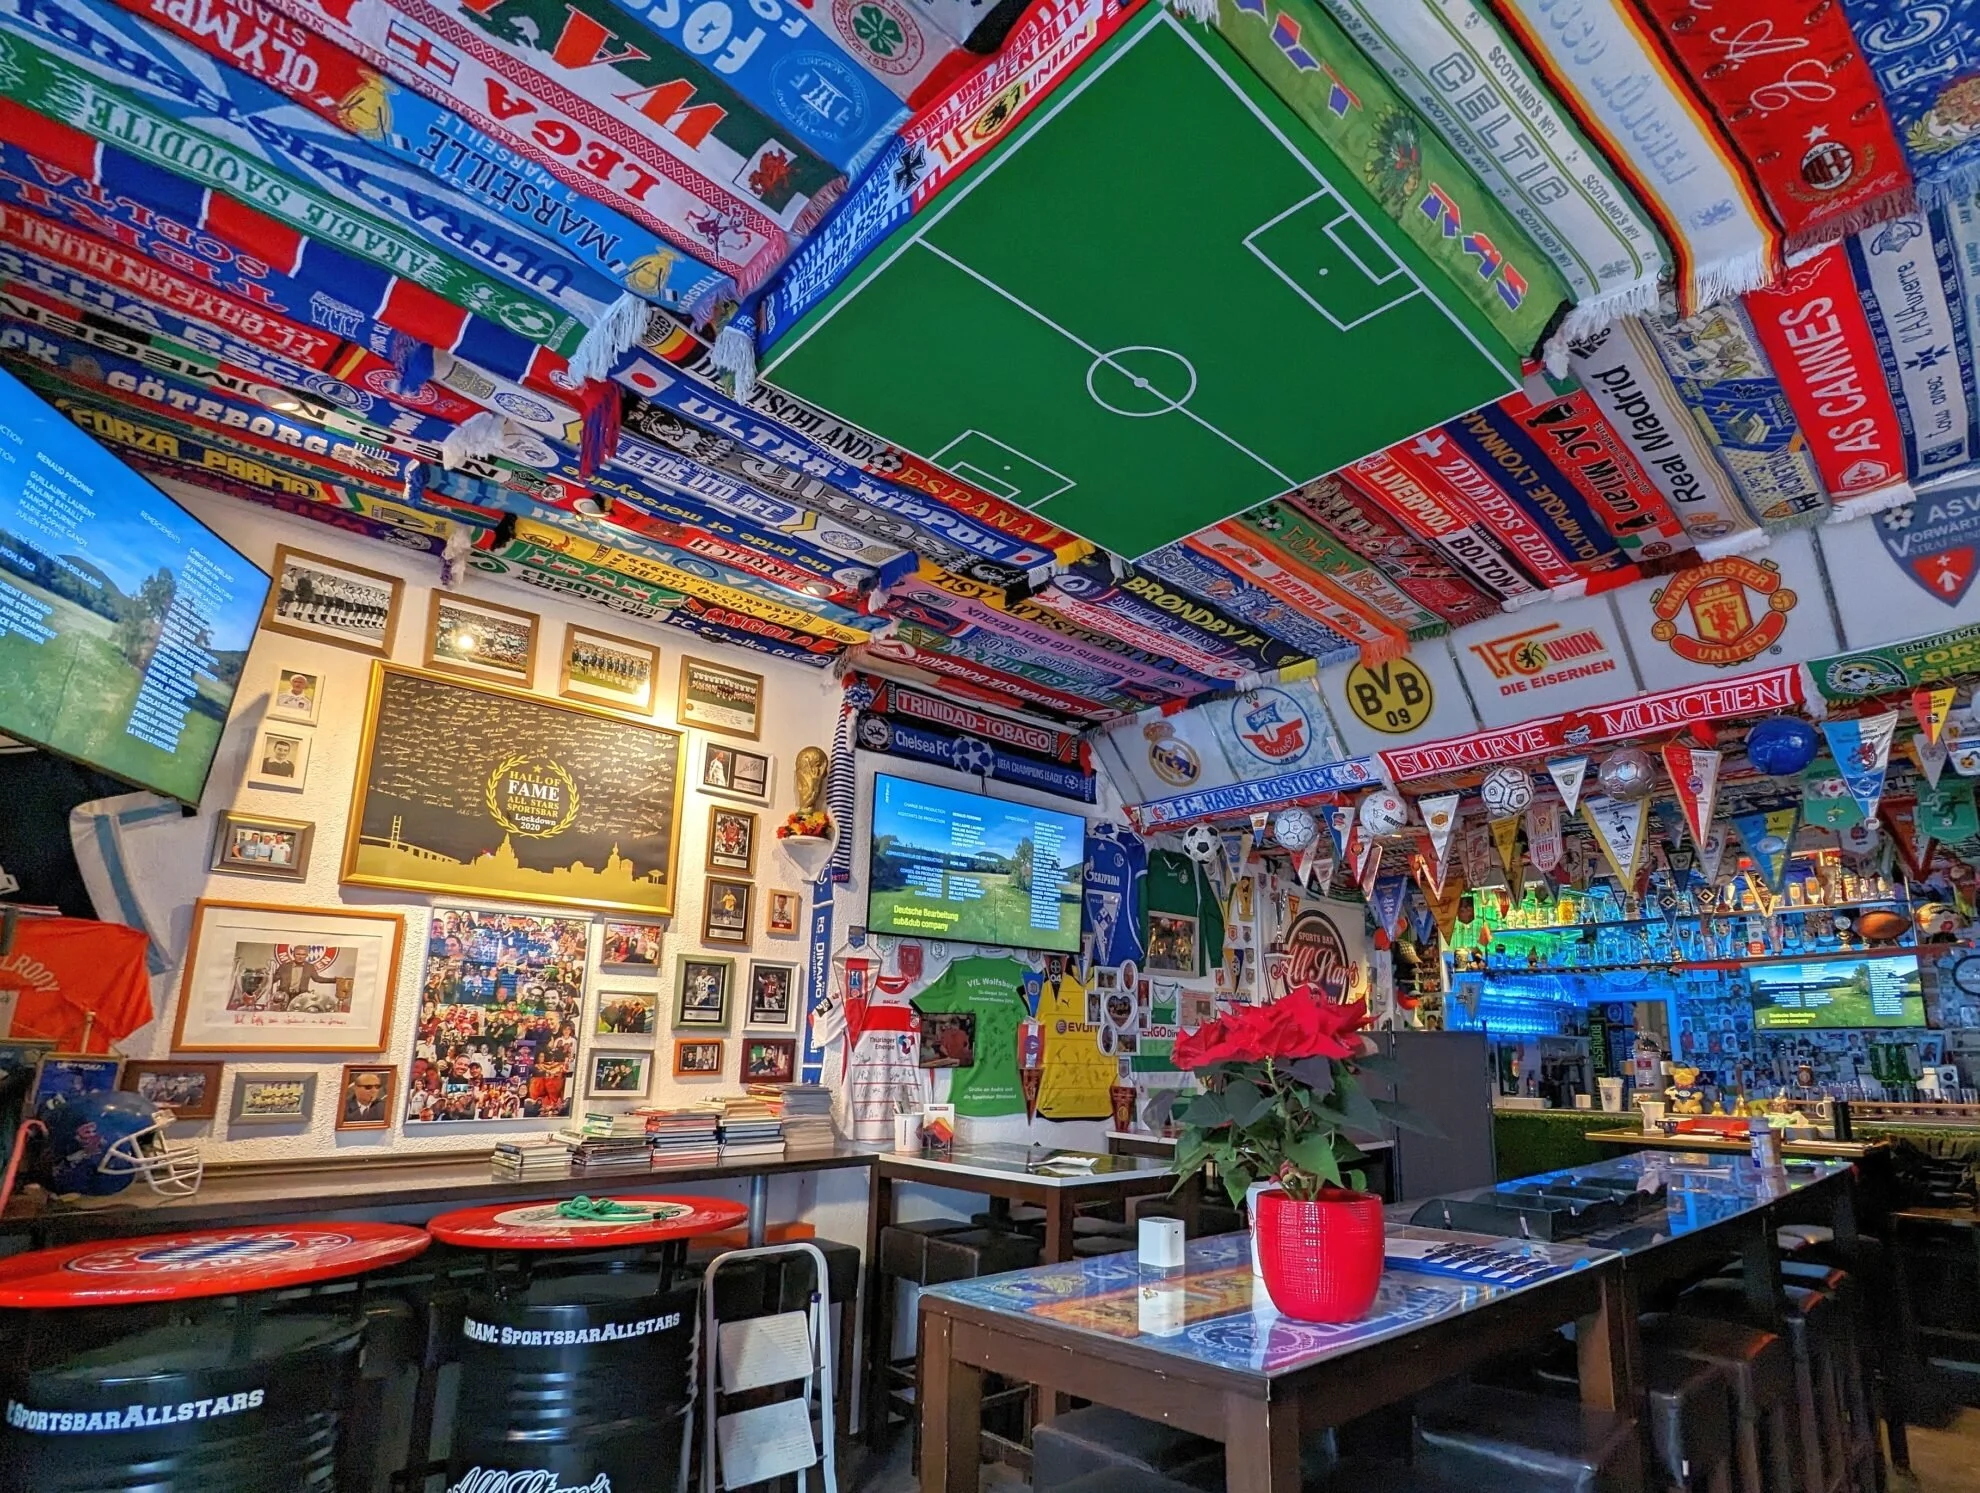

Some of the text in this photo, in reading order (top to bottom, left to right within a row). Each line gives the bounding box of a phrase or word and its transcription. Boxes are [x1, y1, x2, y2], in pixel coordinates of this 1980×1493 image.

[150, 0, 319, 93] OLYMP
[1018, 25, 1093, 95] UNION
[1488, 46, 1544, 117] SCOTLAND'S
[435, 110, 556, 192] MARSEILLE
[484, 78, 660, 201] LEGA
[1429, 52, 1570, 206] CELTIC
[87, 95, 433, 277] ARABIE SAOUDITE
[416, 125, 619, 263] MARSEILLE
[846, 191, 894, 241] BSC
[121, 262, 265, 338] BAYERN
[181, 326, 303, 383] BSC
[1778, 295, 1868, 420] CANNES
[73, 406, 317, 498] FORZA PARMA
[1601, 362, 1707, 505] Real Madrid
[1835, 418, 1881, 453] AS
[36, 451, 96, 497] RENAUD PERONNE
[614, 440, 686, 482] LEEDS
[689, 472, 734, 502] UTD
[734, 491, 785, 523] AFC
[1550, 426, 1640, 514] AC Milan
[15, 509, 40, 528] JULIEN
[18, 499, 66, 533] MARIE-SOPHIE
[22, 489, 49, 510] MANON
[25, 479, 85, 523] PAULINE BATAILLE
[29, 470, 96, 520] GUILLAUME LAURENT
[1369, 464, 1455, 537] LIVERPOOL
[1927, 494, 1980, 524] ASV
[851, 481, 1007, 560] NIPPON
[1529, 482, 1593, 572] OLYMPIQUE
[1886, 516, 1980, 558] VORWÄRT
[706, 519, 832, 573] the pride of
[1446, 532, 1515, 597] BOLTON
[1508, 518, 1563, 583] HOPP
[526, 547, 657, 602] IRAN
[625, 564, 687, 590] CLUBE
[930, 569, 1004, 609] TSV
[1265, 566, 1331, 615] Ferrari
[1662, 562, 1769, 612] MANCHESTER
[696, 586, 755, 613] NOSSO
[1122, 571, 1247, 643] BRØNDBY
[1236, 630, 1265, 650] IF
[669, 615, 795, 660] FC Schalke 04
[701, 606, 814, 649] ANGOLA
[961, 604, 1050, 648] Bordeaux
[1050, 639, 1075, 657] de
[1544, 629, 1604, 663] UNION
[1697, 633, 1768, 660] UNITED
[1354, 661, 1425, 716] BVB
[1500, 658, 1616, 696] DIE EISERNEN
[900, 692, 1049, 749] TRINIDAD-TOBAGO
[1385, 708, 1411, 727] 09
[1395, 727, 1545, 775] SÜDKURVE
[1601, 679, 1784, 737] MÜNCHEN
[895, 731, 951, 758] Chelsea FC
[507, 780, 560, 802] FAME
[508, 796, 560, 810] ALL STARS
[510, 771, 561, 787] HALL OF
[1173, 767, 1335, 817] F.C. HANSA ROSTOCK
[507, 803, 558, 818] SPORTSBAR
[515, 814, 557, 826] Lockdown
[520, 822, 541, 831] 2020
[893, 905, 959, 922] Deutsche Bearbeitung
[893, 917, 949, 932] sub&dub company
[814, 944, 825, 999] DINAMO
[967, 977, 1018, 993] VfL Wolfsburg
[1050, 974, 1062, 983] 04
[869, 1036, 895, 1046] Thüringer
